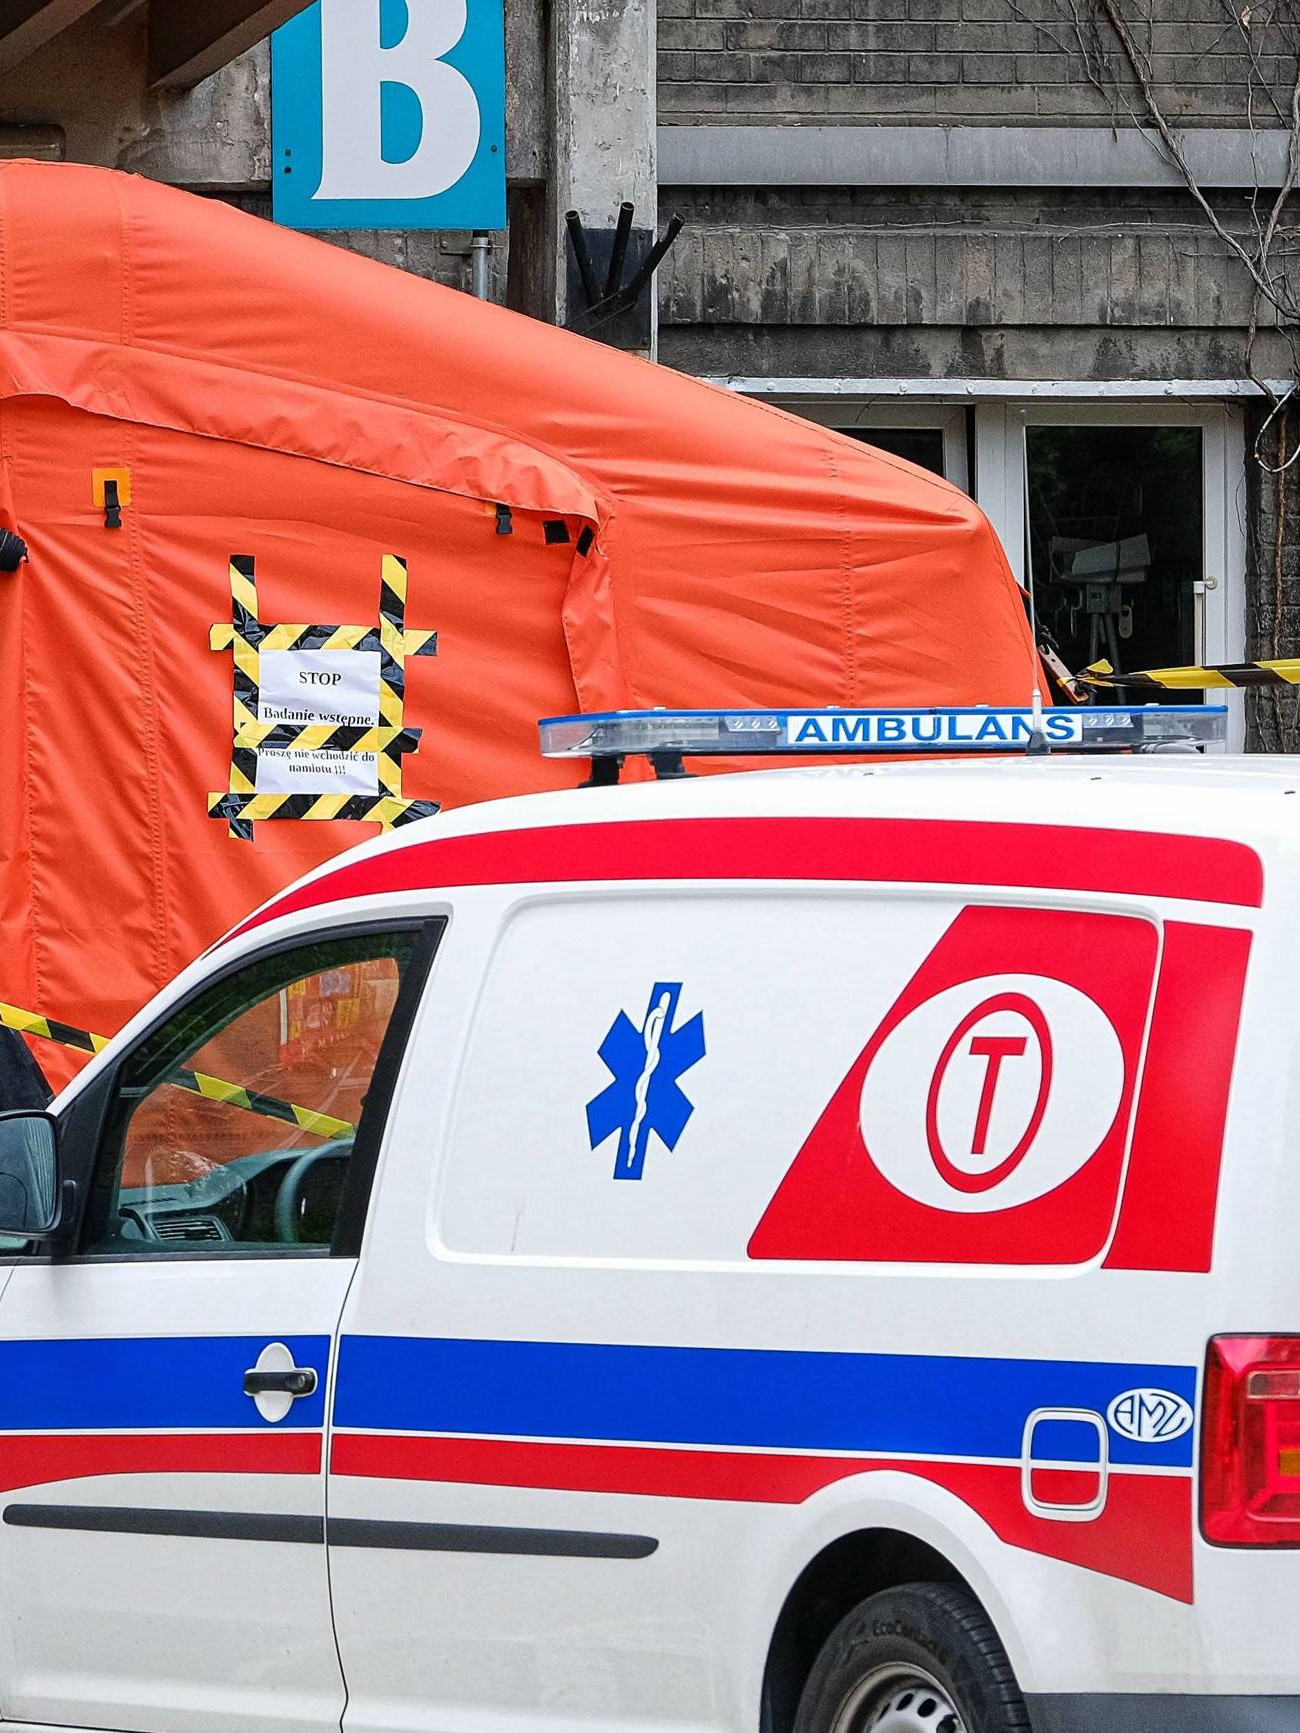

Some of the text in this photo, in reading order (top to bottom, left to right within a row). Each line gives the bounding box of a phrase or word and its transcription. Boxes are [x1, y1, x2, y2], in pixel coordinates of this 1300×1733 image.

[310, 0, 481, 200] B
[299, 671, 342, 686] STOP
[264, 707, 375, 727] Badanie wstępne.
[794, 715, 1075, 742] AMBULANS
[258, 747, 375, 762] Proszę nie wchodzić do
[289, 764, 332, 775] namiotu
[968, 1036, 1028, 1155] T
[1114, 1392, 1187, 1438] AMZ
